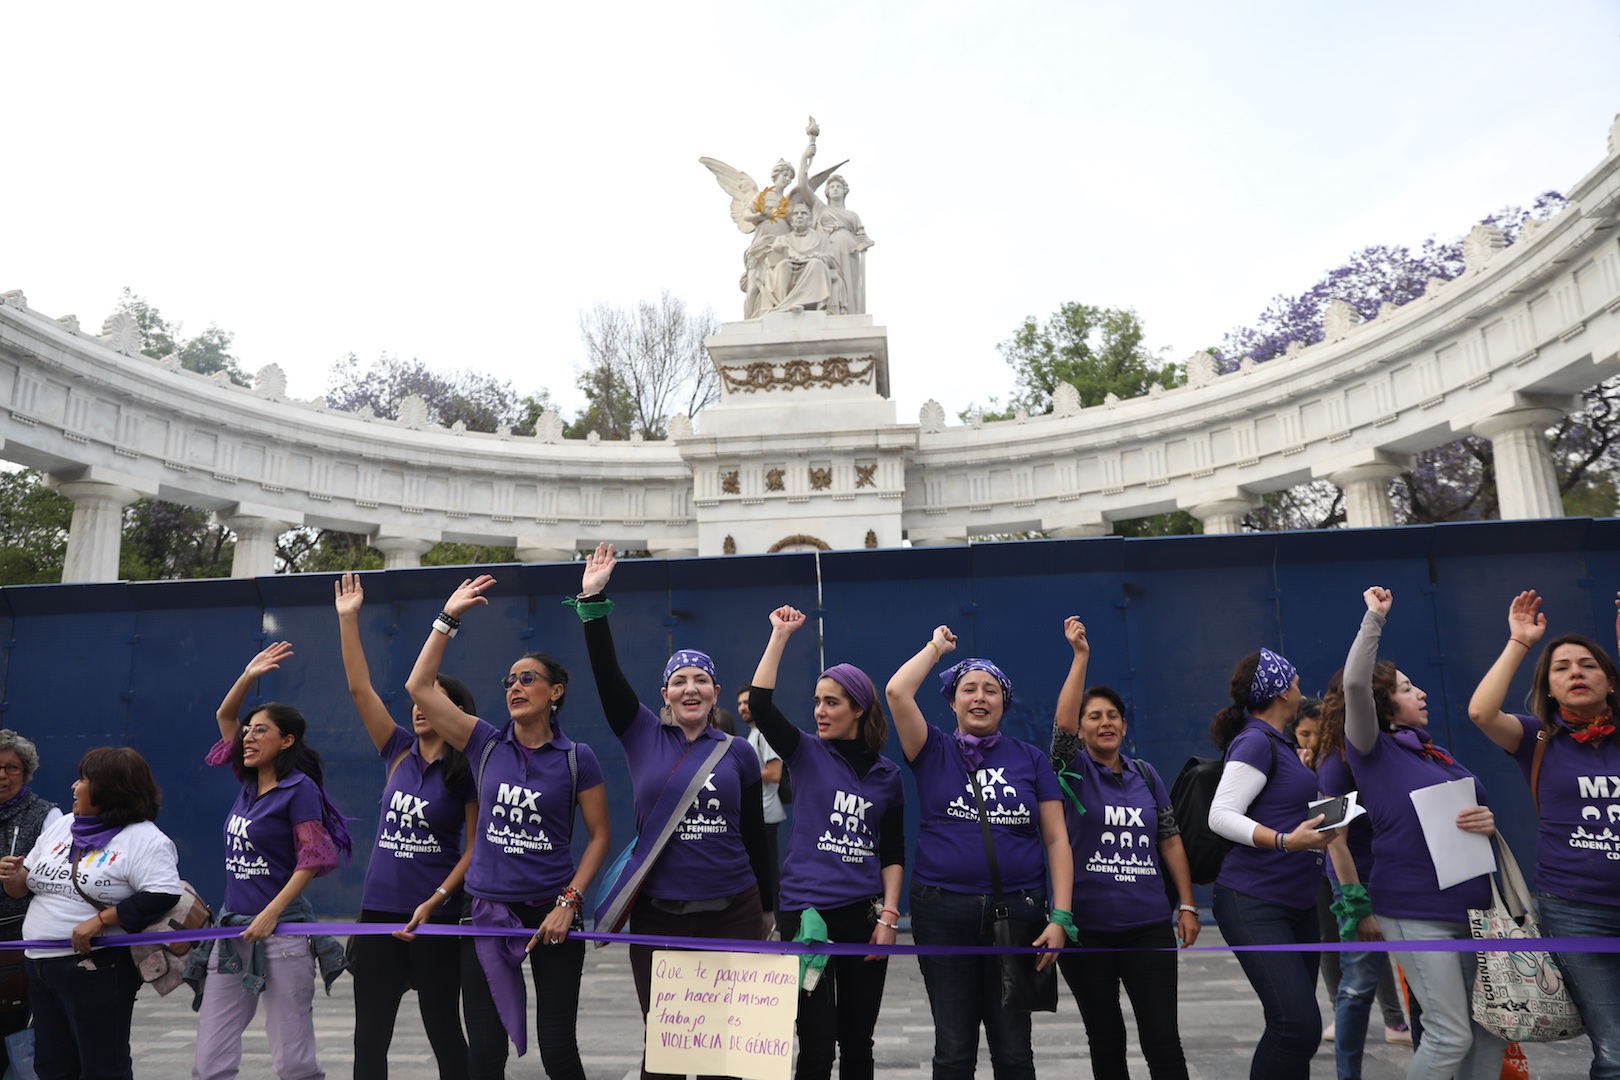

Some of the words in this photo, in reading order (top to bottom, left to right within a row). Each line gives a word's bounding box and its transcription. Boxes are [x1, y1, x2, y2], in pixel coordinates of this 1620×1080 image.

[496, 782, 543, 812] MX
[389, 790, 430, 820] MX
[833, 790, 873, 820] MX
[1104, 805, 1145, 827] MX
[227, 814, 252, 838] MX
[687, 825, 727, 833] FEMINISTA
[400, 843, 442, 853] FEMINISTA
[503, 846, 525, 855] CDMX
[510, 838, 553, 851] FEMINISTA
[816, 842, 847, 855] CADENA
[1569, 839, 1612, 851] CADENA
[394, 851, 415, 859] CDMX
[841, 855, 864, 864] CDMX
[1085, 864, 1119, 874] CADENA
[1121, 866, 1157, 876] FEMINISTA
[94, 879, 112, 887] en
[1114, 874, 1137, 883] CDMX
[656, 959, 683, 979] Que
[693, 960, 708, 979] te
[713, 968, 758, 989] paguen
[763, 970, 797, 985] menos
[655, 992, 677, 1008] por
[684, 988, 721, 1003] hacer
[738, 993, 779, 1007] mismo
[656, 1007, 706, 1032] trabajo
[727, 1015, 741, 1027] es
[661, 1032, 722, 1050] VIOLENCIA
[729, 1035, 741, 1051] DE
[745, 1032, 790, 1057] GÉNERO
